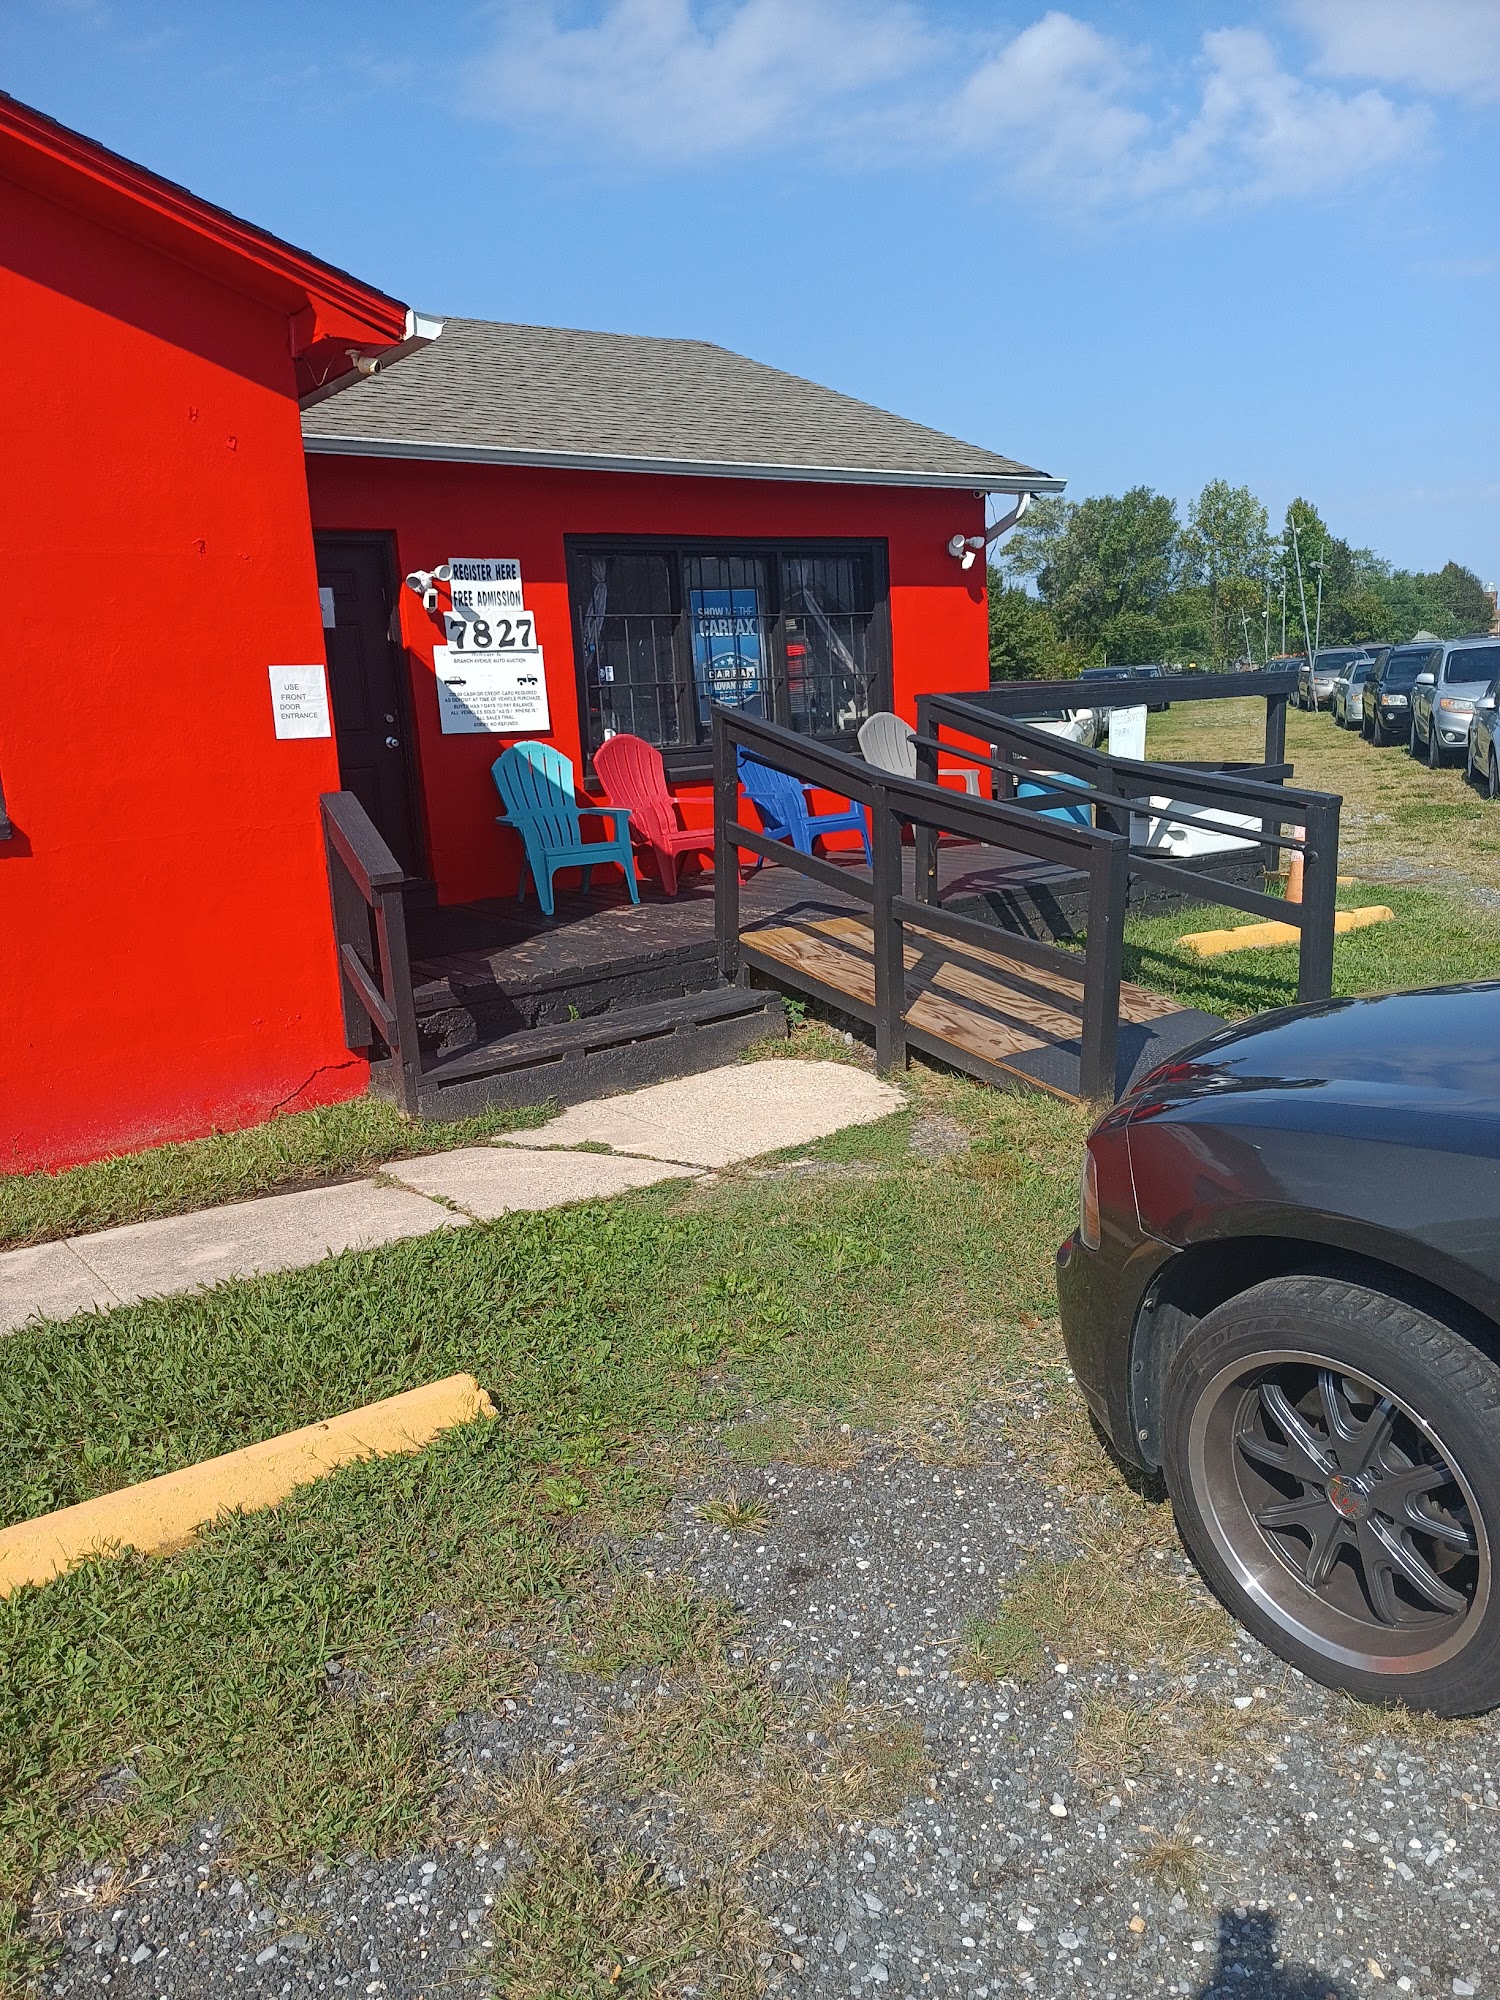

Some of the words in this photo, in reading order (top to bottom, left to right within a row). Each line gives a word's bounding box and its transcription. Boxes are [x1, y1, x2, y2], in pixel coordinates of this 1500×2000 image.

[453, 564, 491, 580] REGISTER
[495, 564, 516, 580] HERE
[453, 591, 473, 607] FREE
[478, 590, 521, 606] ADMISSION
[698, 607, 723, 618] SHOW
[739, 607, 753, 616] THE
[450, 619, 532, 649] 7827
[699, 619, 756, 637] CARFAX
[708, 669, 754, 679] CARFAX
